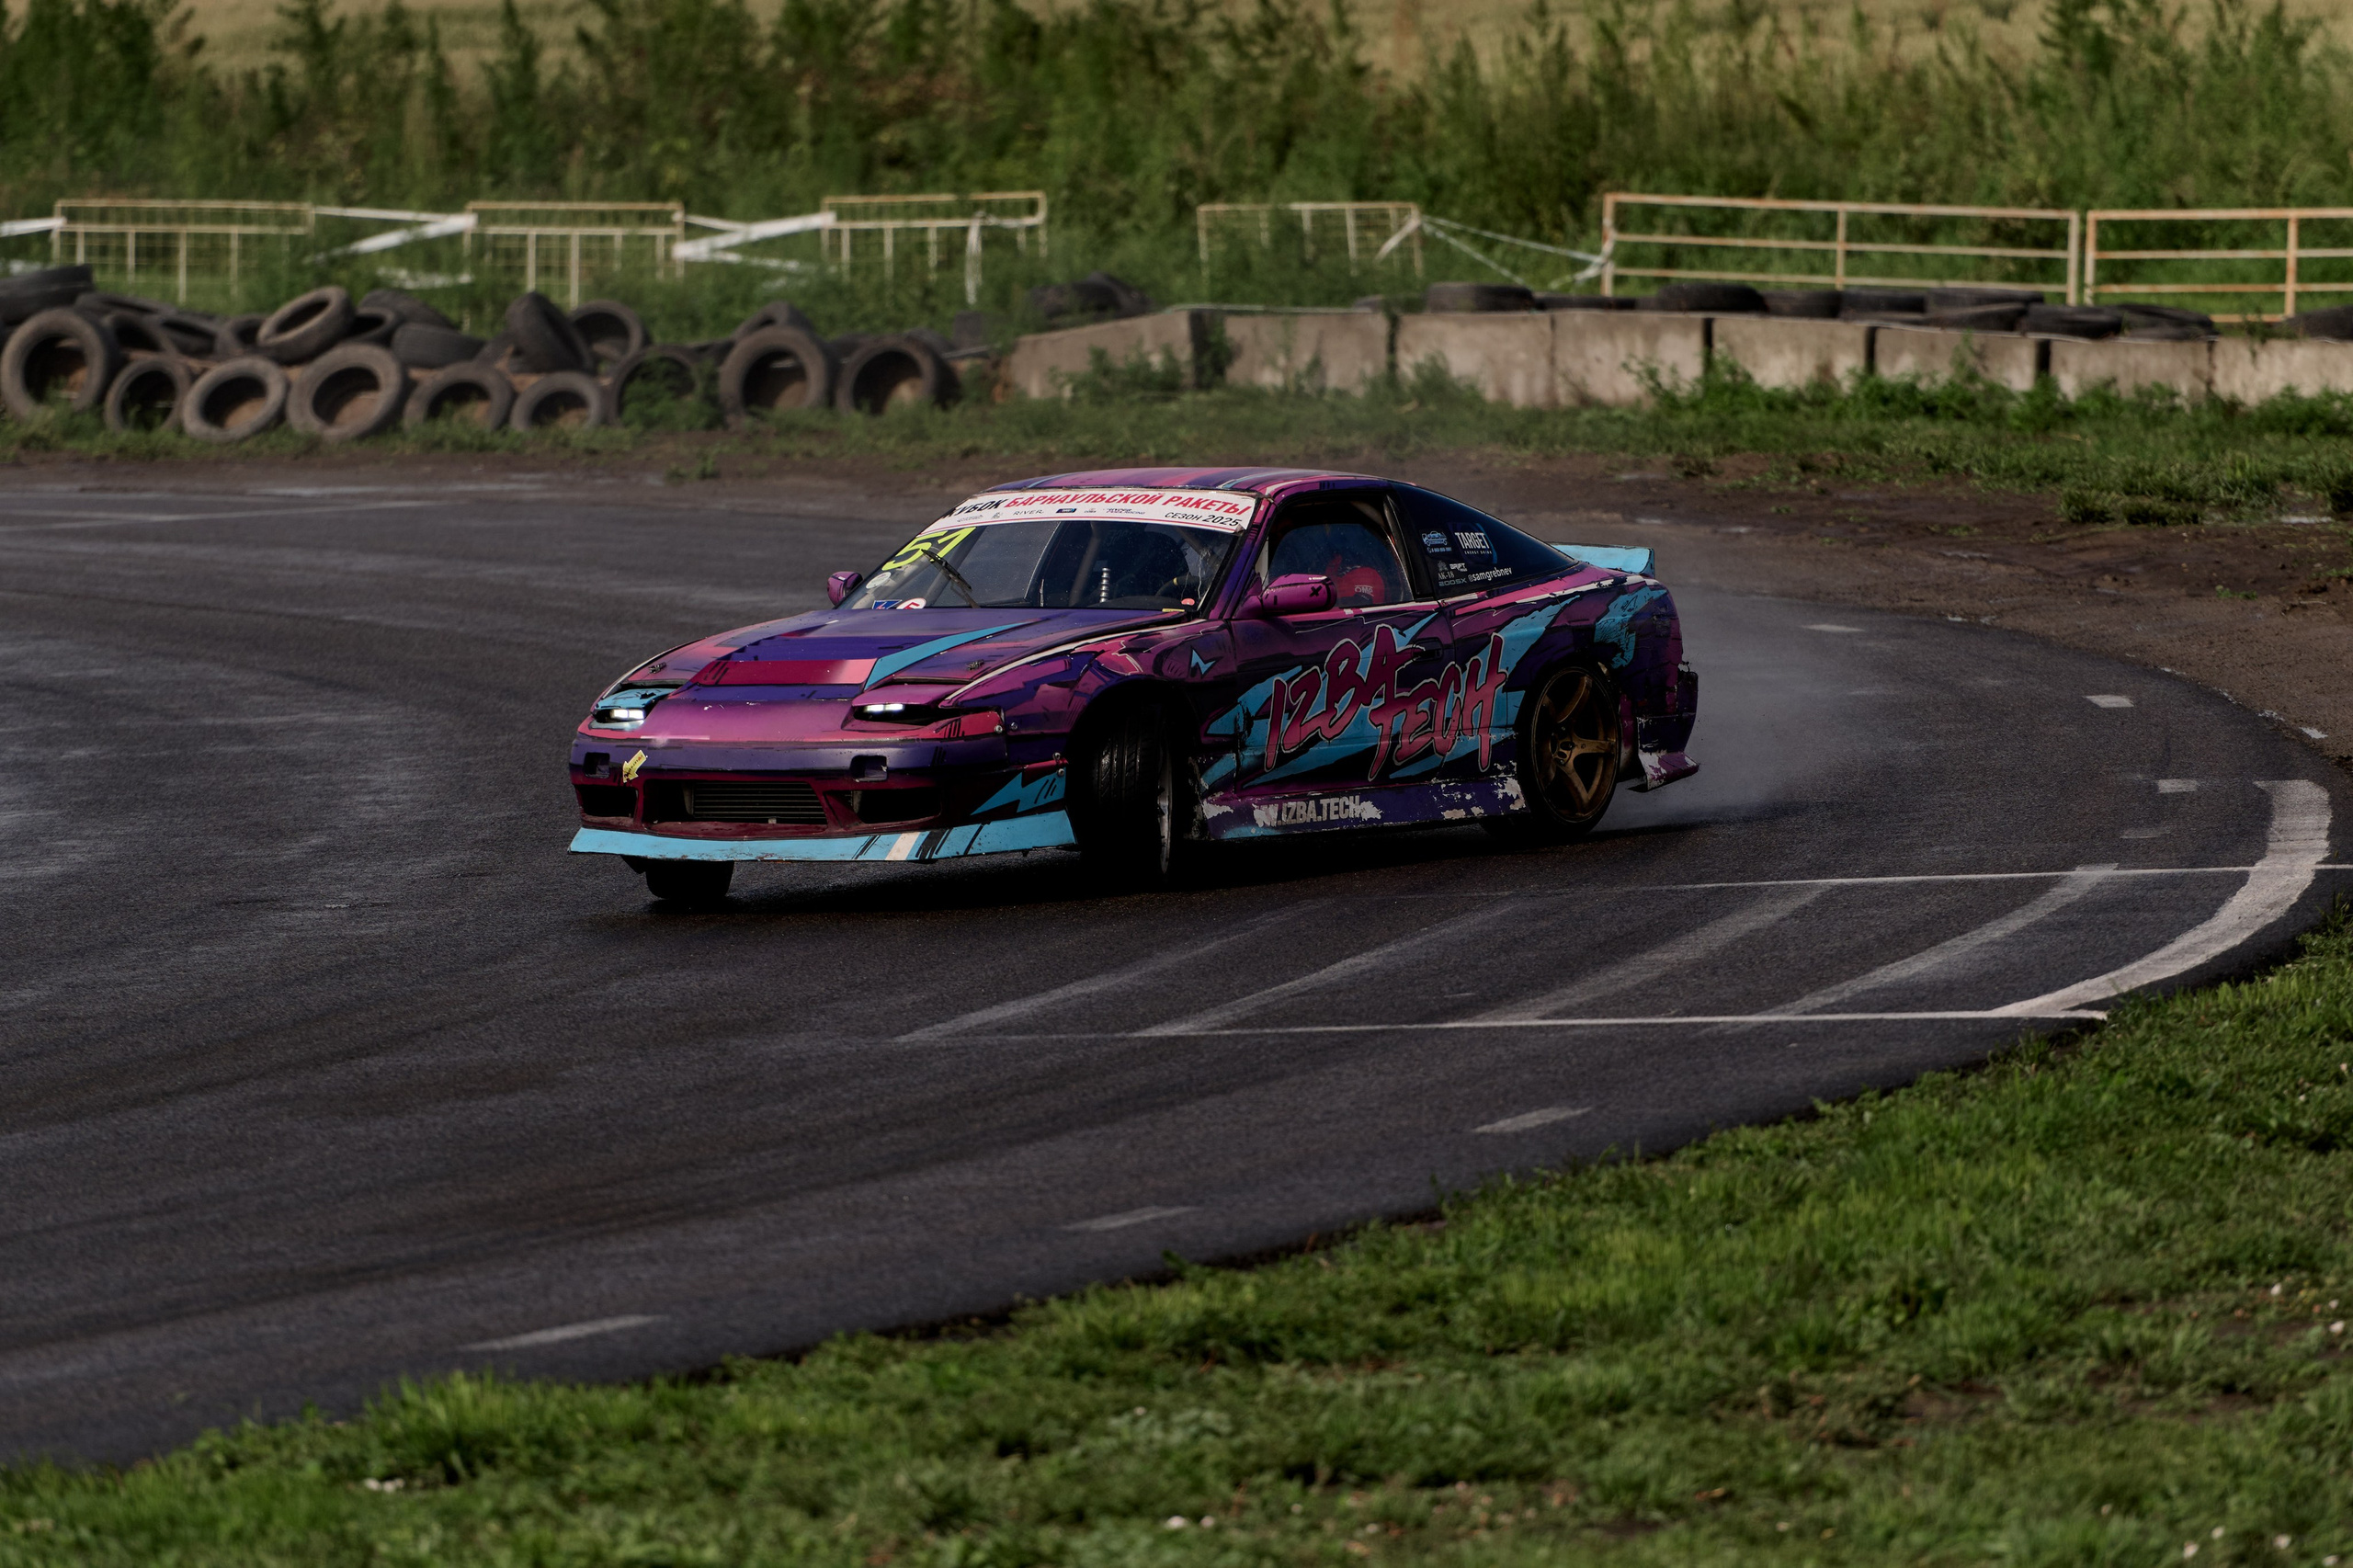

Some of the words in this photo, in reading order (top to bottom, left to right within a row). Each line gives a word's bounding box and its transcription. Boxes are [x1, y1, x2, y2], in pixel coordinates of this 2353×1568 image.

[1003, 493, 1165, 507] БАРНАУЛЬСКОЙ
[1162, 495, 1252, 515] РАКЕТЫ
[1165, 512, 1201, 521] СЕЗОН
[1202, 515, 1243, 527] 2025
[882, 527, 976, 570] 51
[1454, 532, 1490, 550] TARGET
[1438, 578, 1467, 586] 200SX
[1467, 566, 1513, 583] @samgrebnev
[1368, 631, 1508, 781] TECH
